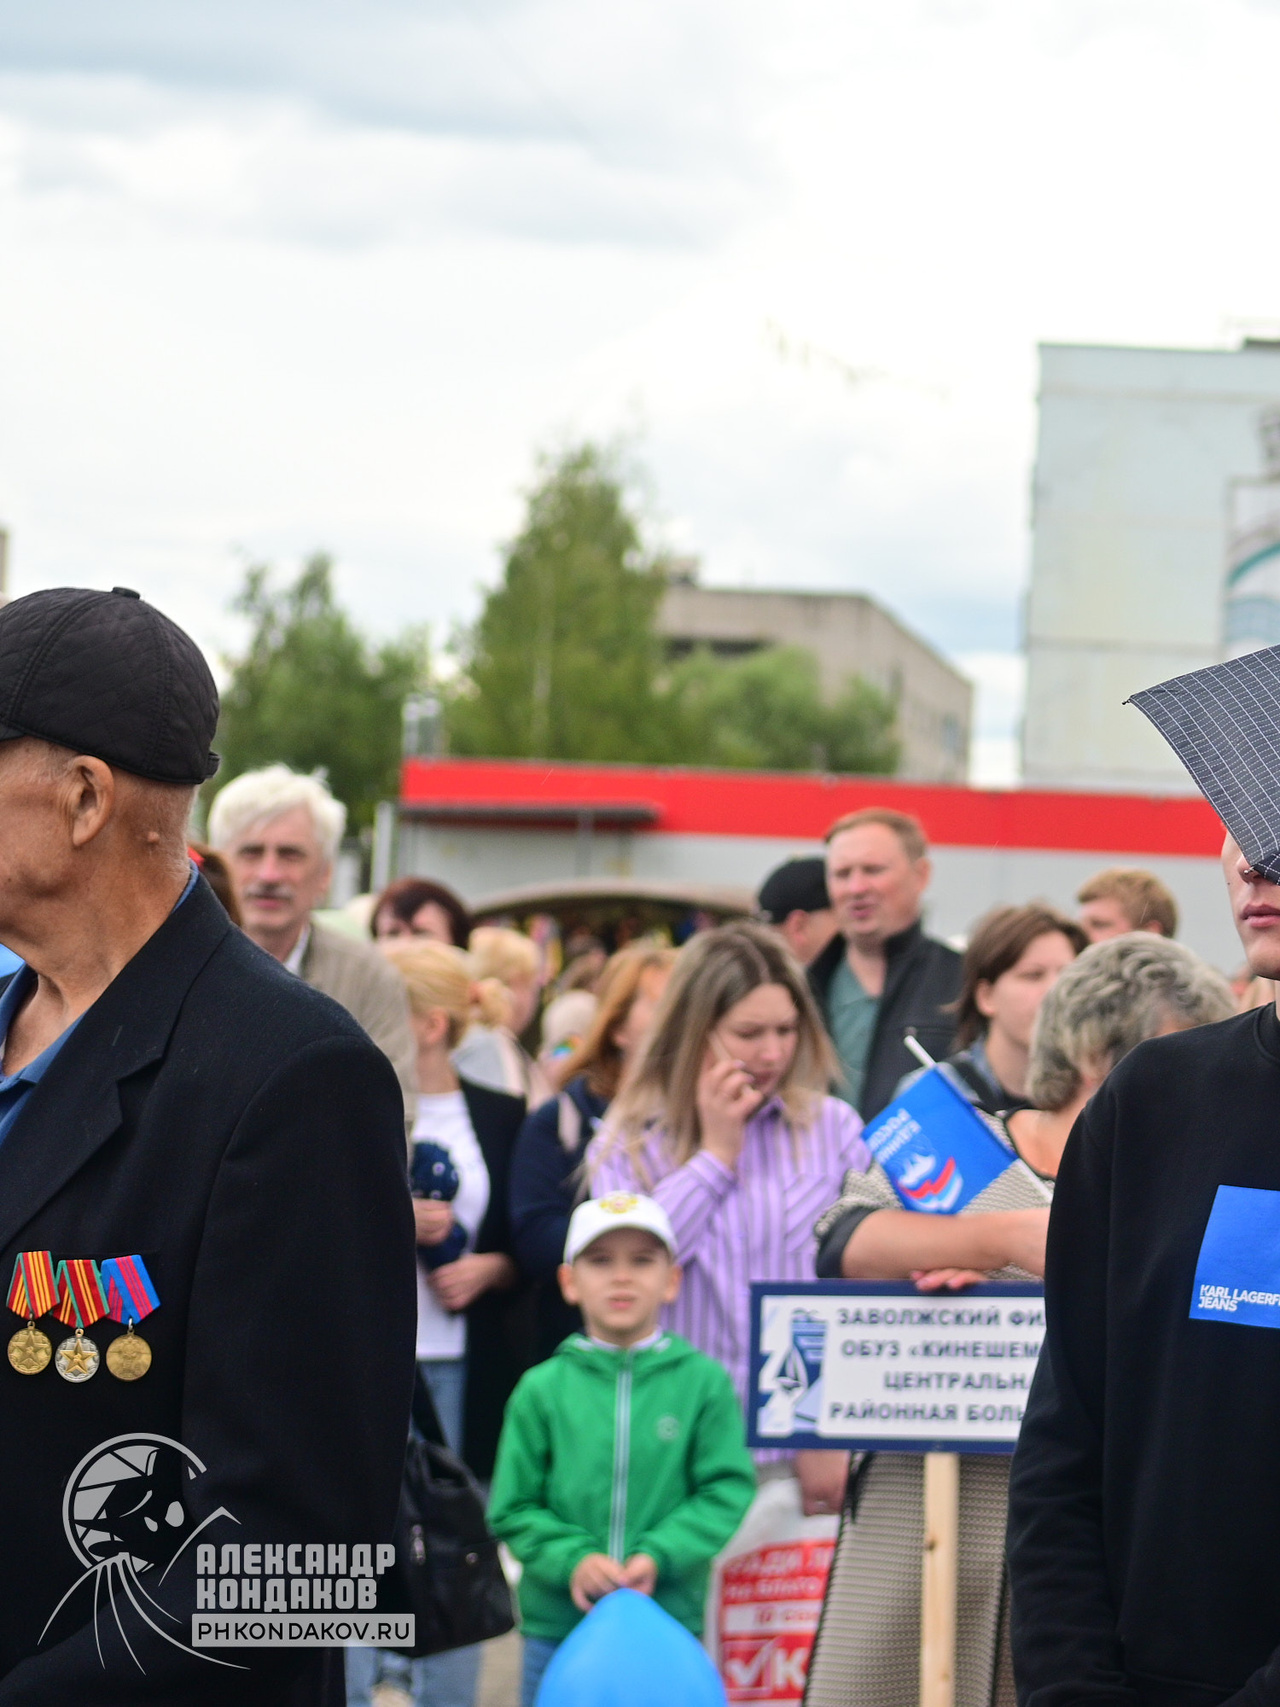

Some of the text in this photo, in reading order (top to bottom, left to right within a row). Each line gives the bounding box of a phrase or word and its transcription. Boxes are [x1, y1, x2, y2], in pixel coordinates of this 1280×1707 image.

[1200, 1284, 1231, 1300] KARL
[1198, 1296, 1238, 1312] JEANS
[837, 1305, 1046, 1326] ЗАВОЛЖСКИЙ ФИ
[841, 1340, 898, 1358] ОБУЗ
[884, 1371, 1030, 1391] ЦЕНТРАЛЬН
[830, 1400, 957, 1422] РАЙОННАЯ
